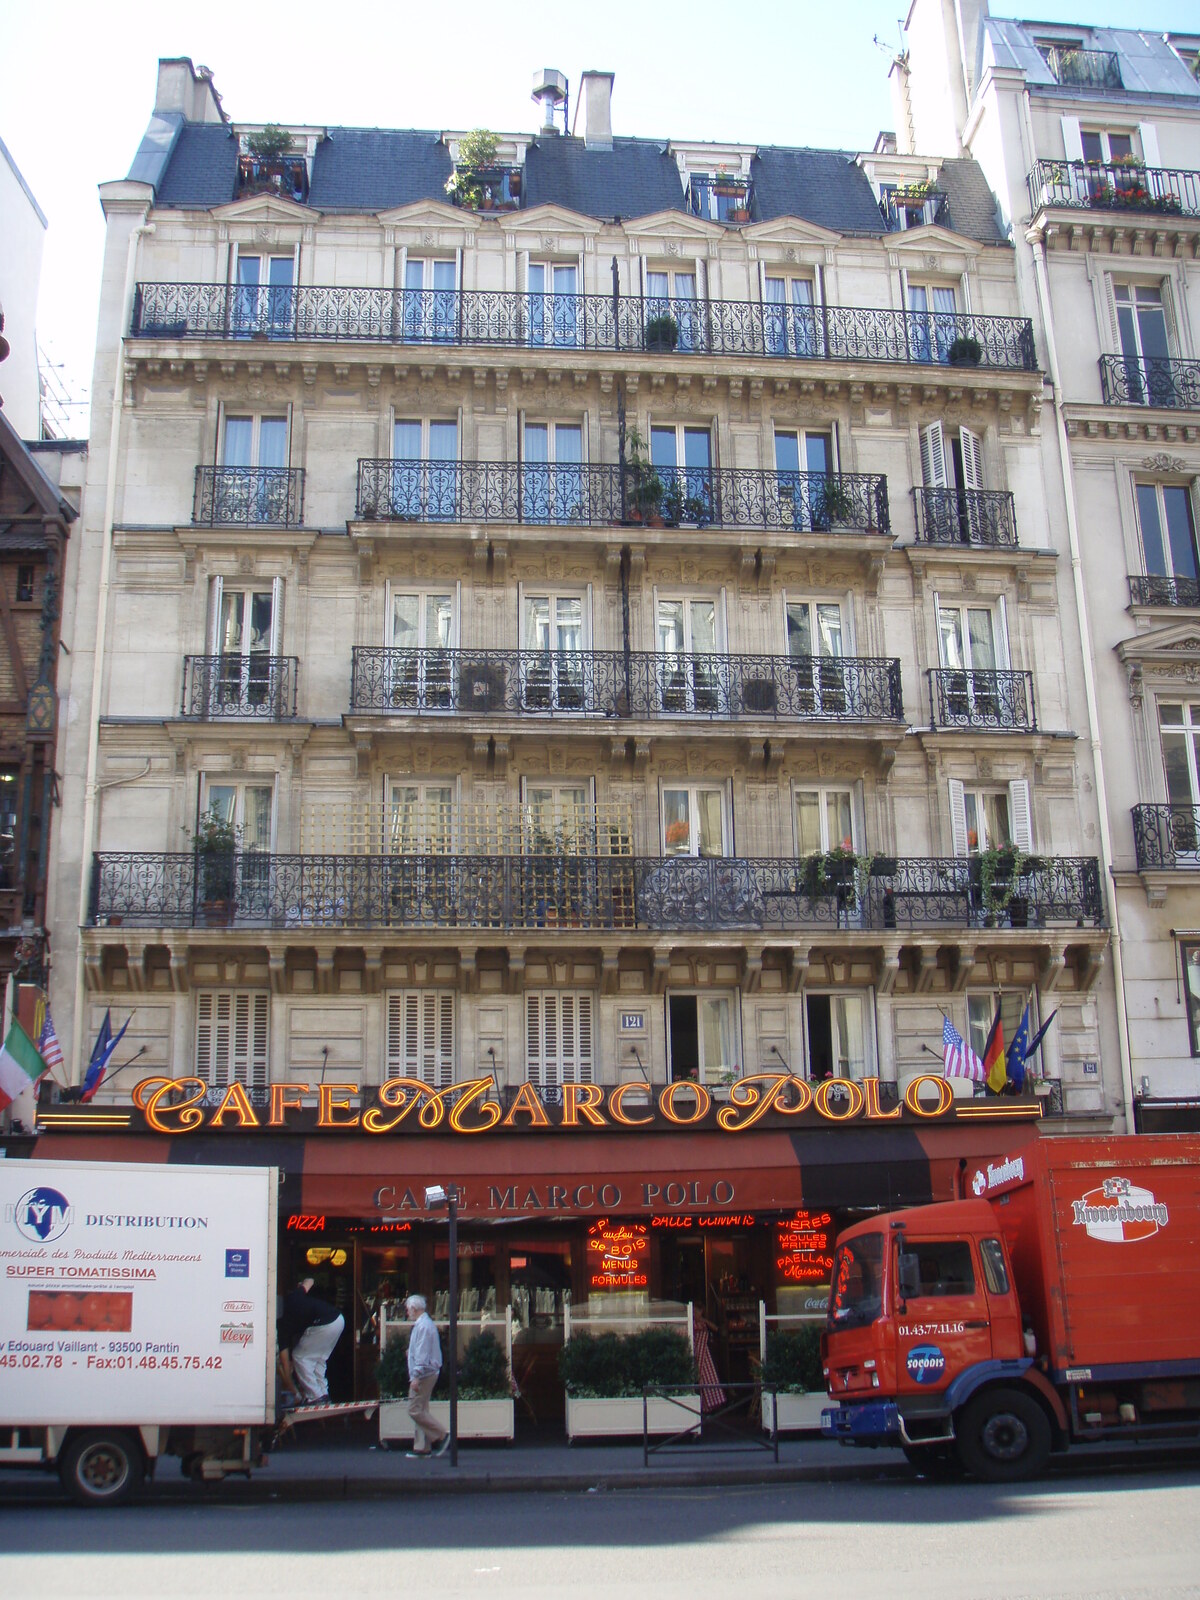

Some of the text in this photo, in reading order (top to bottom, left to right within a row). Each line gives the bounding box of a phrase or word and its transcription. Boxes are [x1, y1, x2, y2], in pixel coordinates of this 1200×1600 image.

[625, 1015, 641, 1027] 121
[132, 1073, 954, 1133] CAFE MARCO POLO
[373, 1180, 736, 1211] CAE MARCO POLO
[1070, 1200, 1169, 1227] Kronenbourg
[85, 1214, 209, 1229] DISTRIBUTION
[286, 1214, 326, 1231] PIZZA
[777, 1213, 831, 1230] IERES
[779, 1233, 828, 1242] MOULES
[590, 1238, 646, 1255] de BOIS
[52, 1249, 69, 1260] des
[74, 1249, 118, 1260] Produits
[121, 1249, 202, 1262] Mediterraneens
[777, 1253, 834, 1269] PAELLAS
[602, 1260, 638, 1269] MENUS
[6, 1265, 157, 1278] SUPER TOMATISSIMA
[785, 1266, 825, 1279] Maison
[591, 1275, 647, 1285] FORMULES
[898, 1323, 965, 1336] 01.43.77.11.16
[8, 1341, 54, 1352] Edouard
[57, 1341, 98, 1352] Vaillant
[109, 1343, 142, 1353] 93500
[145, 1343, 180, 1353] Pantin
[87, 1356, 223, 1369] Fax:01.48.45.75.42
